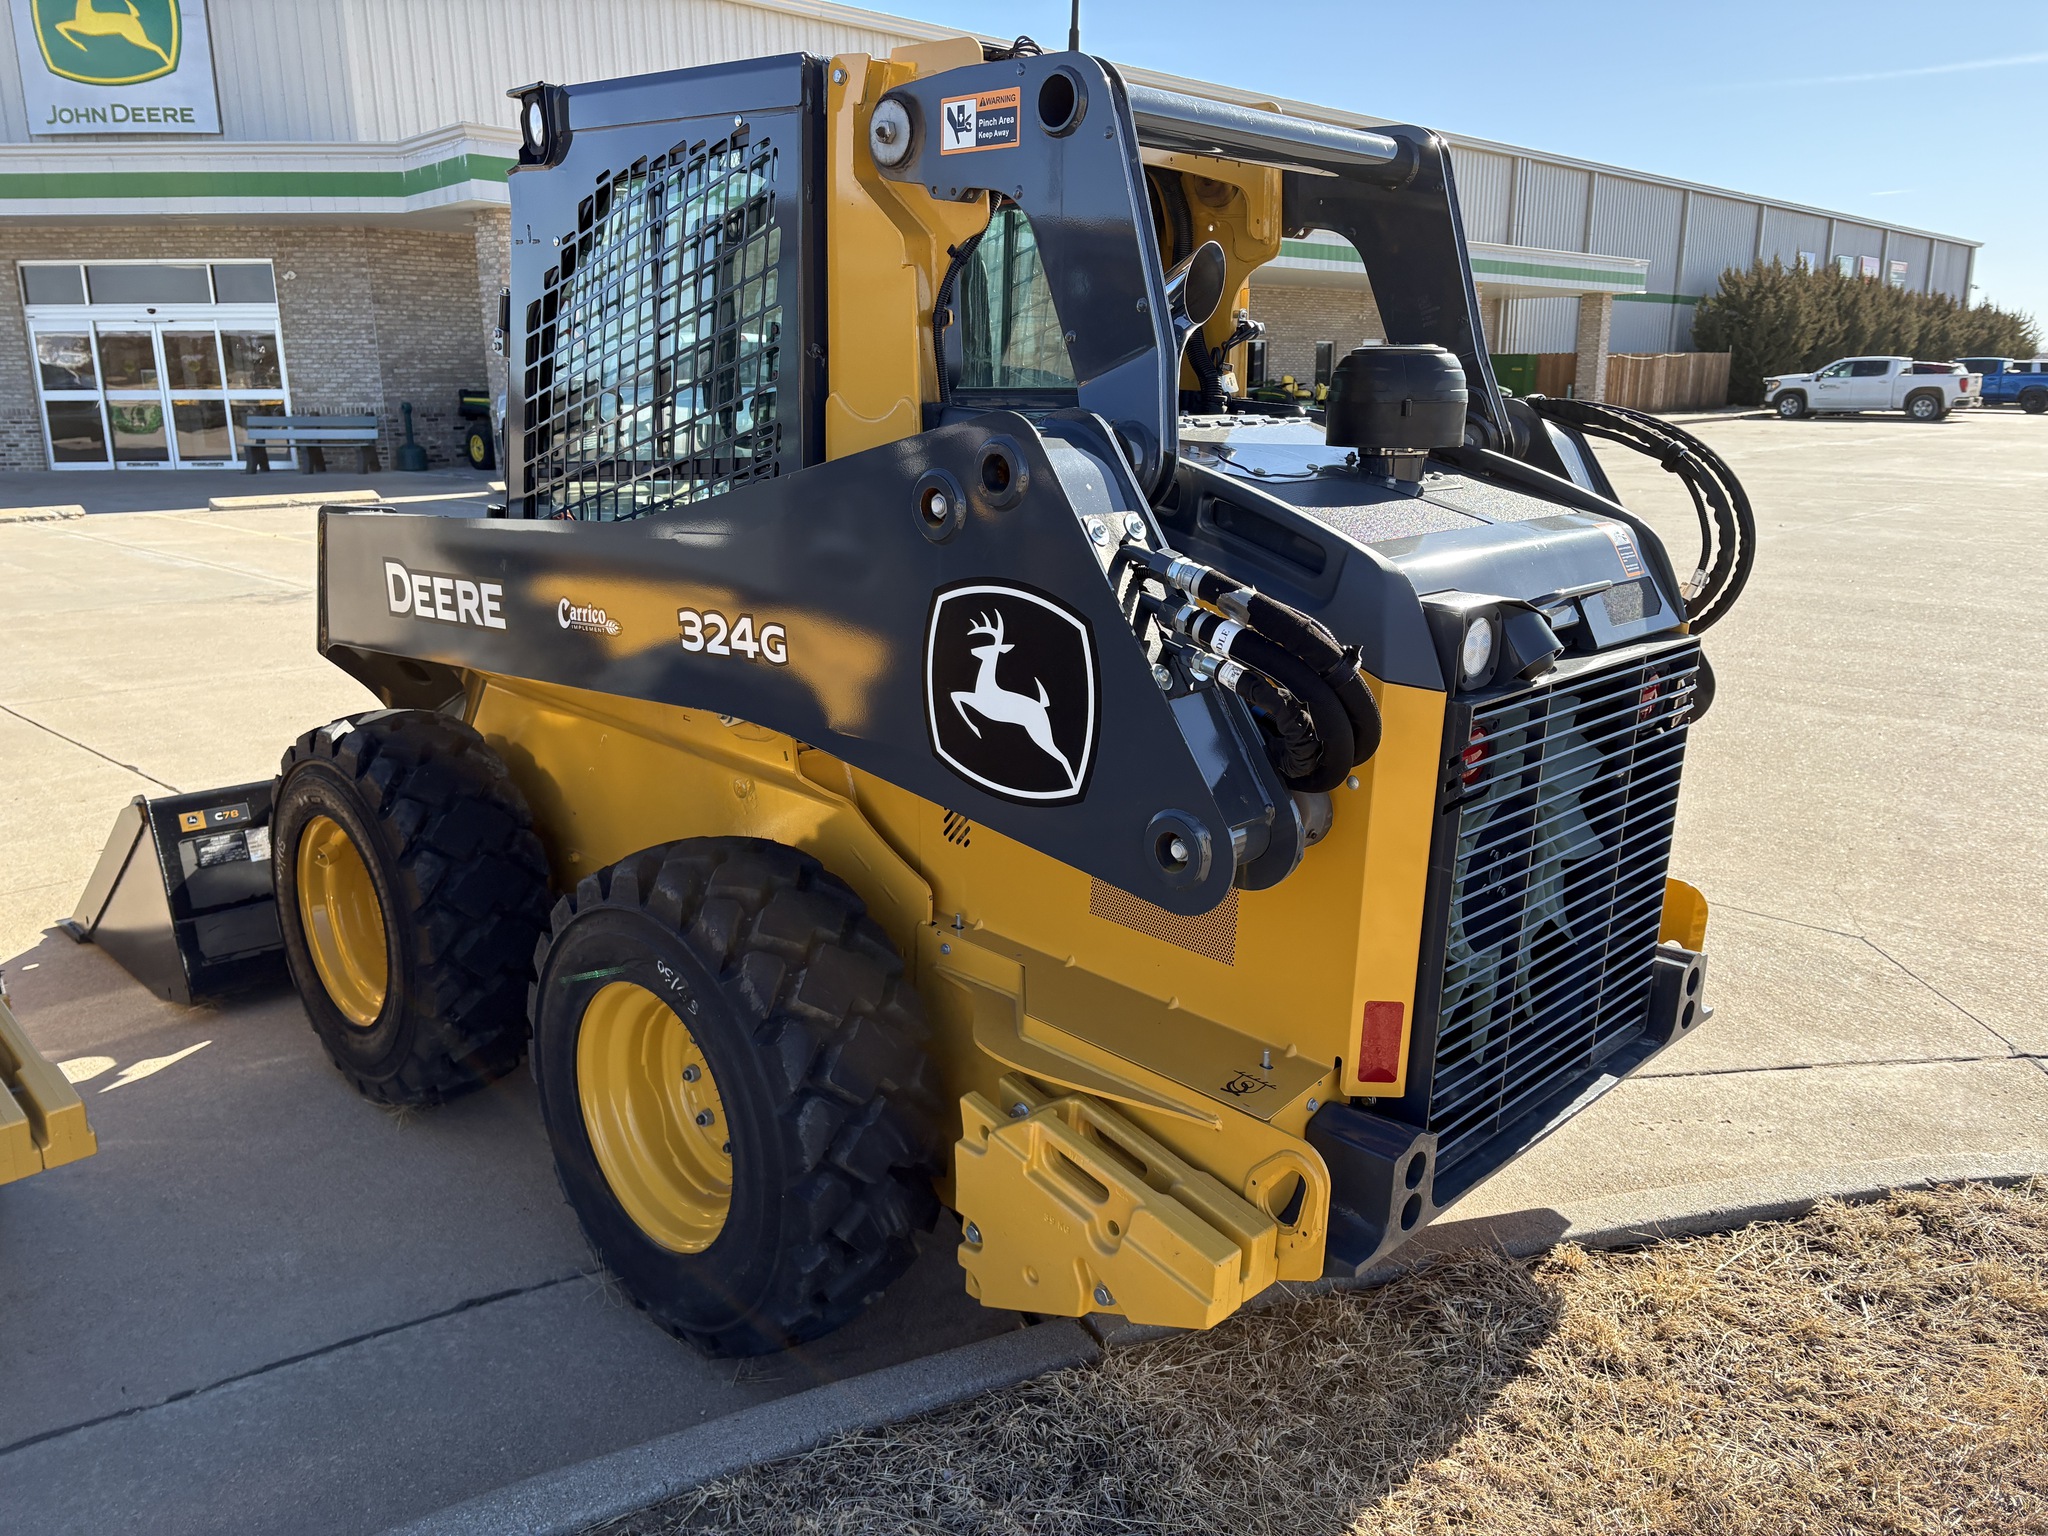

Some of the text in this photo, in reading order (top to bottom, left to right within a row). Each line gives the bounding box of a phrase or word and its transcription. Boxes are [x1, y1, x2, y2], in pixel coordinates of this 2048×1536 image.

[986, 94, 1015, 105] WARNING
[46, 103, 196, 125] JOHN DEERE
[978, 115, 1015, 128] Pinch Area
[978, 129, 1010, 139] Keep Away
[385, 562, 507, 630] DEERE
[558, 597, 607, 629] Carrico
[571, 624, 606, 633] IMPLEMENT
[679, 611, 787, 663] 324G
